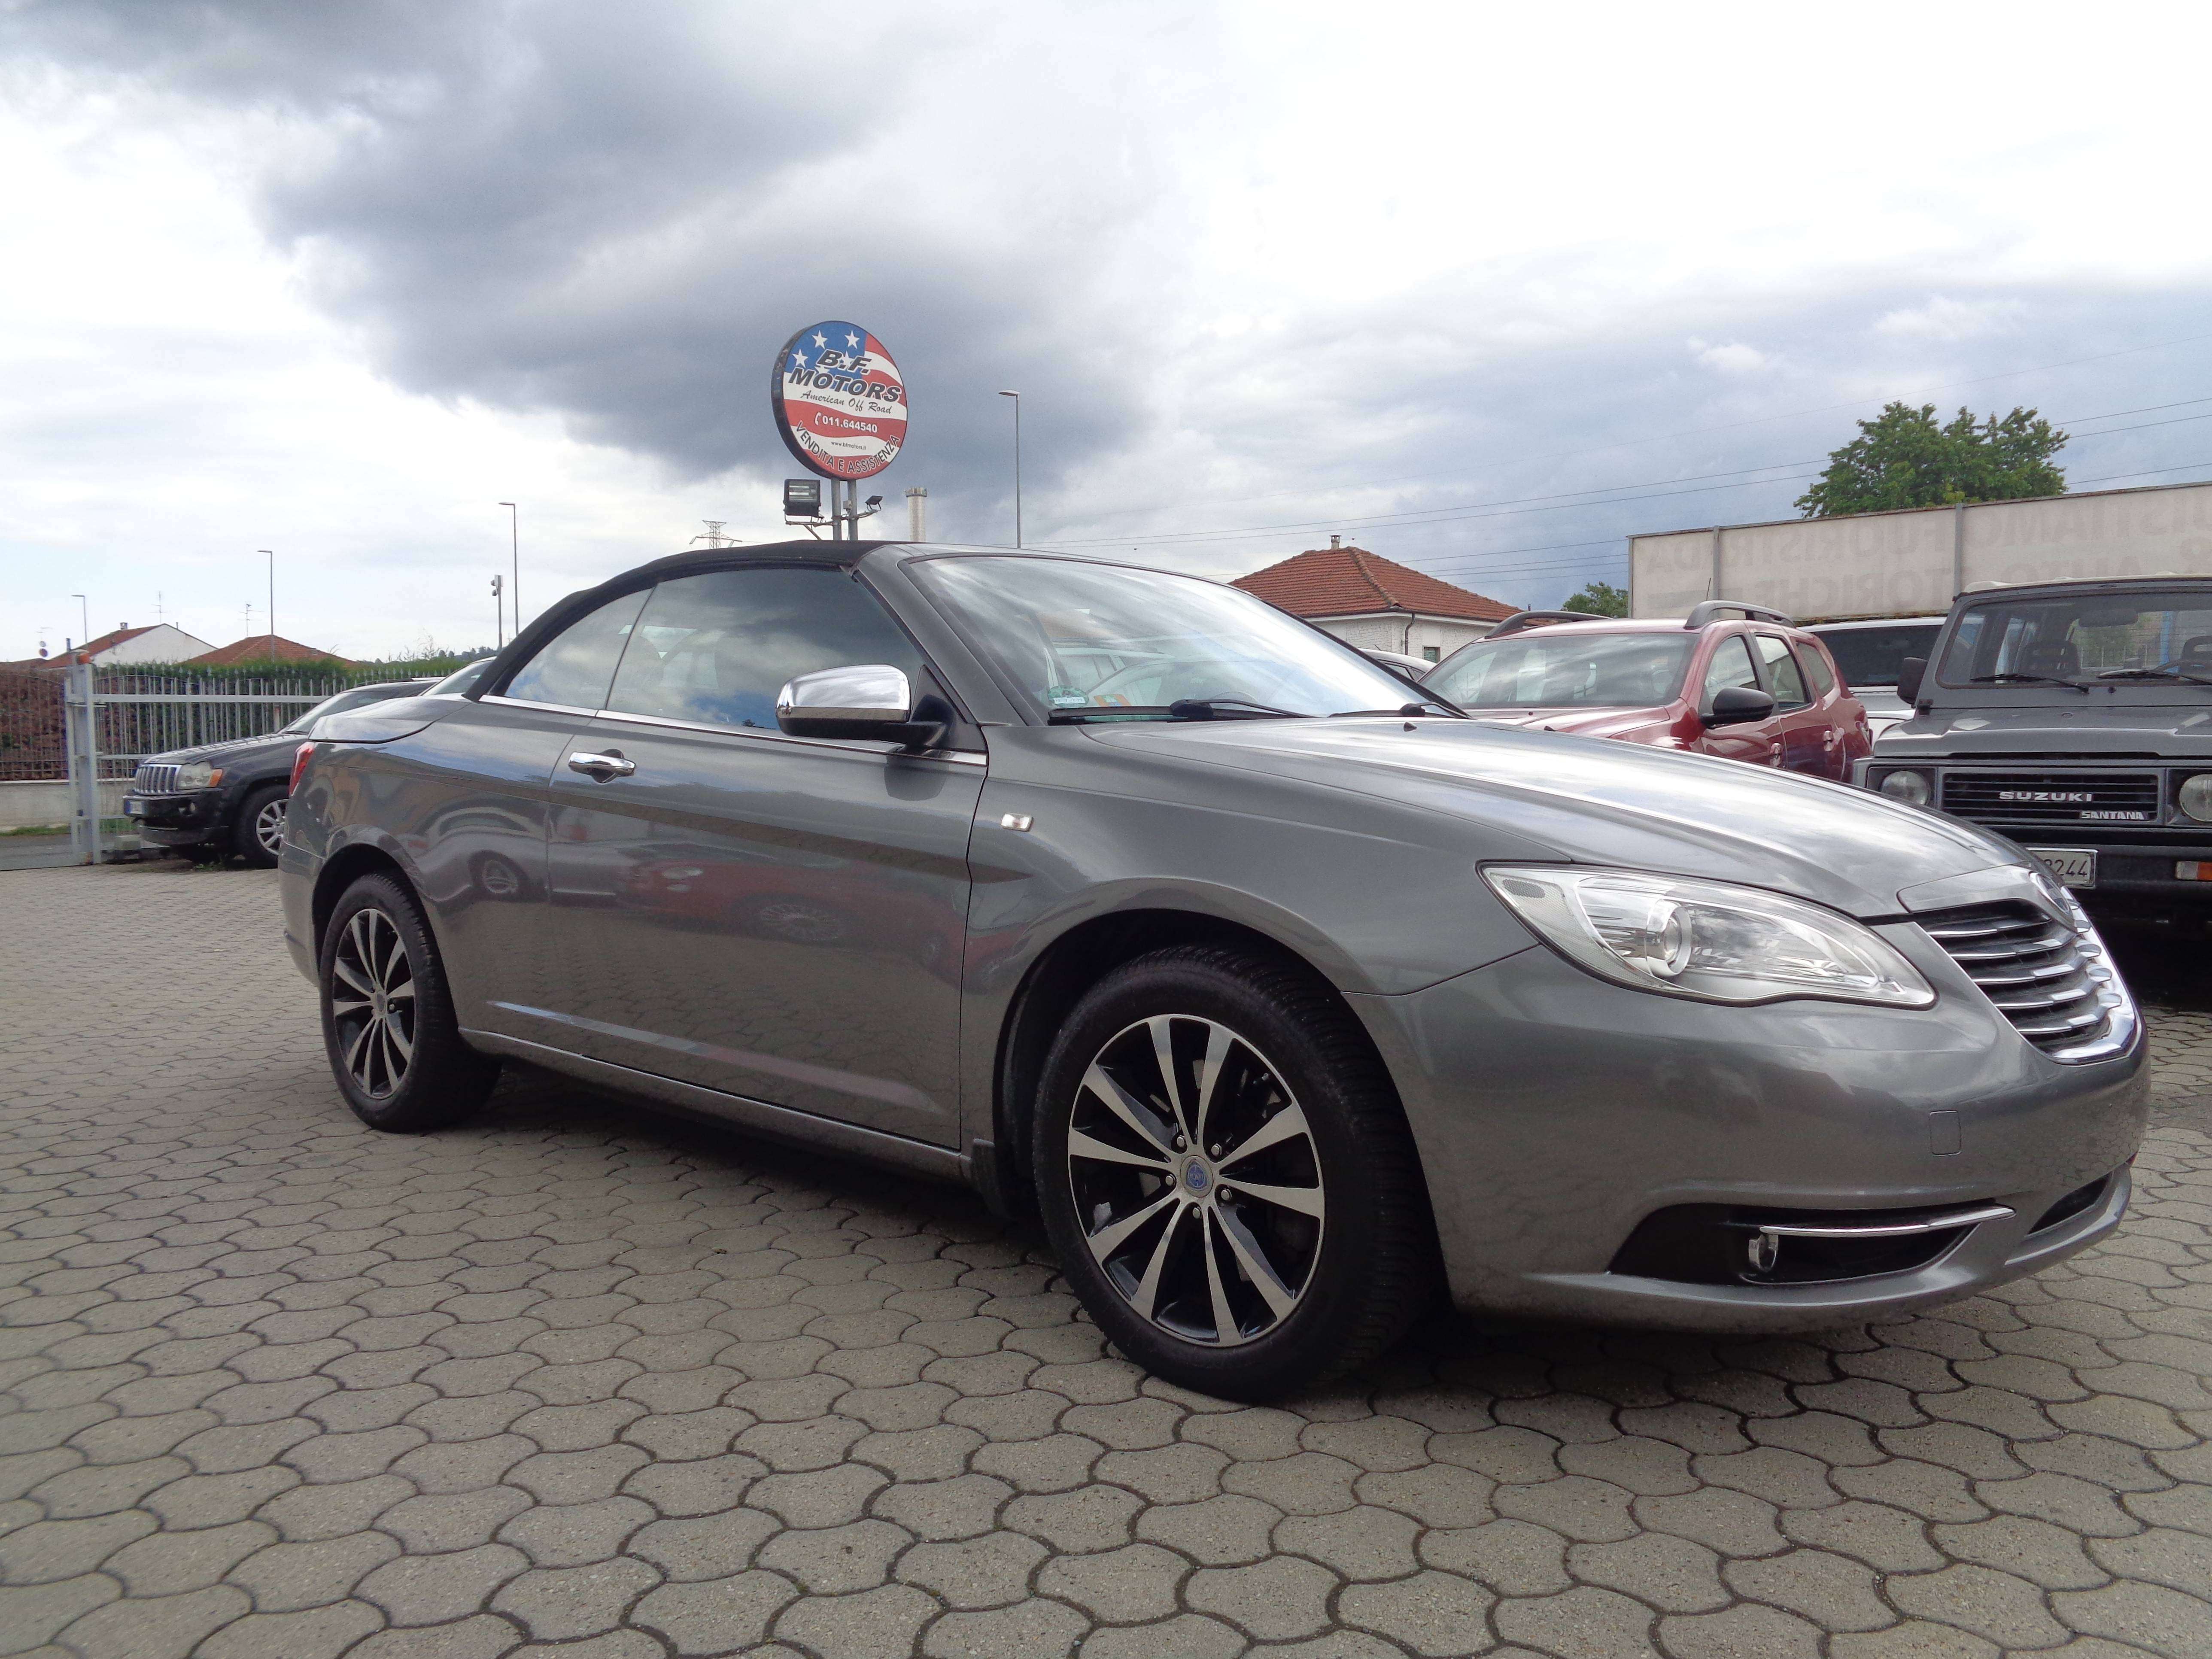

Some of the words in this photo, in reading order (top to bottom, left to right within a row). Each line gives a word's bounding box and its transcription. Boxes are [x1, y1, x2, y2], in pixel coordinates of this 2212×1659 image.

[817, 349, 872, 375] B.F.
[788, 367, 901, 402] MOTORS
[801, 390, 845, 405] American
[848, 398, 864, 412] Off
[868, 402, 892, 414] Road
[822, 416, 878, 433] 011.644540
[796, 421, 834, 468] VENDITA
[838, 459, 845, 472] E
[847, 435, 900, 474] ASSISTENZA
[1999, 791, 2092, 802] SUZUKI
[2081, 811, 2145, 820] SANTANA
